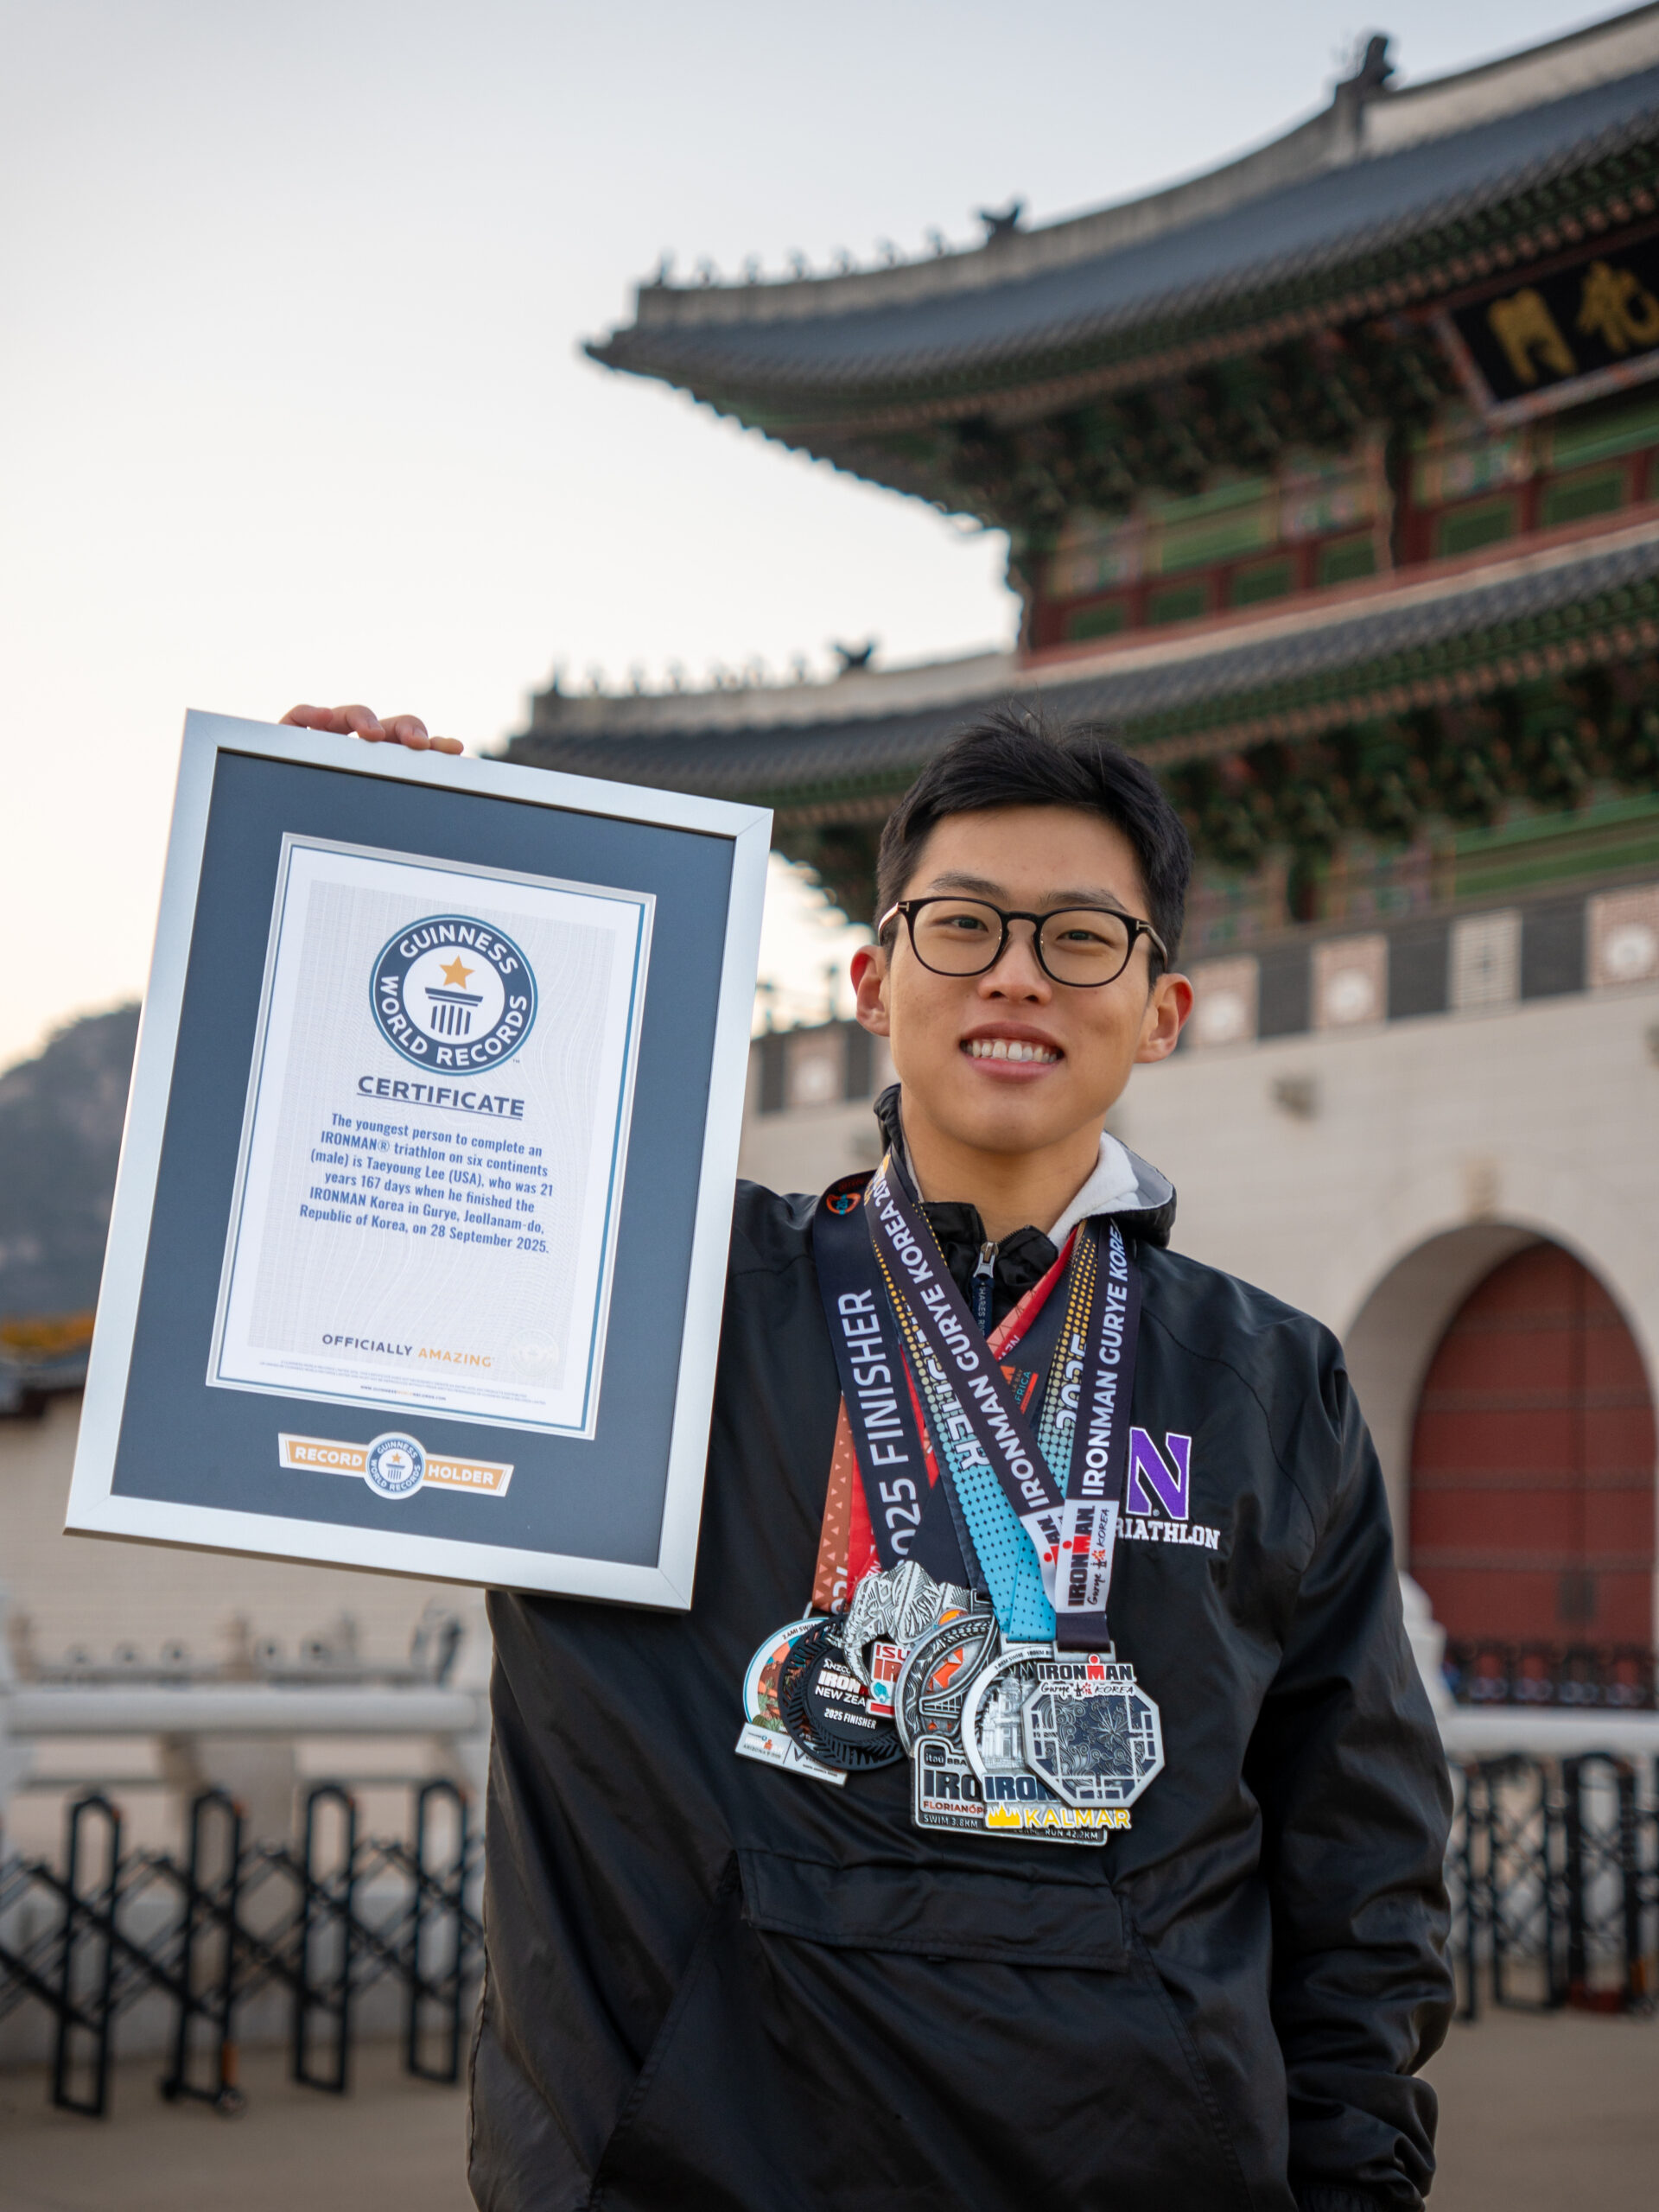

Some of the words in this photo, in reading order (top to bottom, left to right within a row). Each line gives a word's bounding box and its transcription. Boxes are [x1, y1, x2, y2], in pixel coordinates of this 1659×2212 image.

[399, 925, 518, 975] GUINNESS
[380, 976, 429, 1055] WORLD
[435, 995, 527, 1066] RECORDS
[357, 1075, 525, 1117] CERTIFICATE
[331, 1112, 353, 1128] The
[355, 1119, 410, 1137] youngest
[411, 1128, 453, 1144] person
[455, 1133, 468, 1147] to
[470, 1137, 525, 1155] complete
[528, 1146, 543, 1158] an
[310, 1147, 349, 1168] (male)
[352, 1157, 363, 1168] is
[366, 1156, 423, 1179] Taeyoung
[424, 1165, 445, 1180] Lee
[448, 1168, 485, 1188] (USA),
[488, 1176, 512, 1191] who
[515, 1182, 537, 1195] was
[539, 1182, 554, 1198] 21
[394, 1141, 446, 1162] triathlon
[448, 1153, 463, 1165] on
[467, 1154, 483, 1167] six
[486, 1159, 549, 1178] continents
[309, 1185, 367, 1207] IRONMAN
[369, 1195, 404, 1213] Korea
[407, 1201, 420, 1215] in
[423, 1203, 460, 1223] Gurye,
[463, 1209, 544, 1236] Jeollanam-do,
[324, 1172, 357, 1186] years
[361, 1174, 382, 1190] 167
[384, 1178, 411, 1196] days
[415, 1184, 445, 1199] when
[448, 1187, 463, 1203] he
[466, 1191, 512, 1211] finished
[515, 1198, 535, 1214] the
[299, 1203, 353, 1224] Republic
[355, 1213, 369, 1227] of
[371, 1214, 409, 1234] Korea,
[412, 1224, 428, 1236] on
[429, 1223, 447, 1238] 28
[448, 1226, 513, 1249] September
[516, 1236, 550, 1254] 2025.
[880, 1199, 934, 1284] KOREA
[1109, 1220, 1128, 1282] KORE
[978, 1286, 987, 1318] HARLES
[919, 1283, 980, 1372] GURYE
[1098, 1282, 1128, 1365] GURYE
[321, 1333, 414, 1357] OFFICIALLY
[417, 1347, 493, 1369] AMAZING
[837, 1288, 910, 1466] FINISHER
[1014, 1370, 1032, 1405] FRICA
[377, 1441, 418, 1459] GUINNESS
[967, 1375, 1051, 1509] IRONMAN
[1081, 1370, 1118, 1496] IRONMAN
[295, 1446, 364, 1467] RECORD
[428, 1464, 494, 1485] HOLDER
[371, 1459, 387, 1488] WORLD
[389, 1465, 421, 1492] RECORDS
[1126, 1427, 1192, 1521] N
[878, 1478, 922, 1565] 025
[1096, 1508, 1110, 1548] KOREA
[1115, 1517, 1221, 1551] RIATHLON
[1065, 1505, 1096, 1607] IRONMAN
[875, 1643, 911, 1662] ISU
[1038, 1659, 1135, 1681] IRONMAN
[815, 1685, 843, 1701] NEW
[1094, 1685, 1135, 1694] KOREA
[823, 1708, 843, 1721] 2025
[843, 1713, 878, 1730] FINISHER
[947, 1758, 968, 1766] BBA
[923, 1800, 984, 1815] FLORIANÓP
[923, 1815, 949, 1825] SWIM
[951, 1817, 978, 1828] 3.8KM
[1045, 1828, 1064, 1838] RUN
[1024, 1808, 1132, 1828] KALMAR
